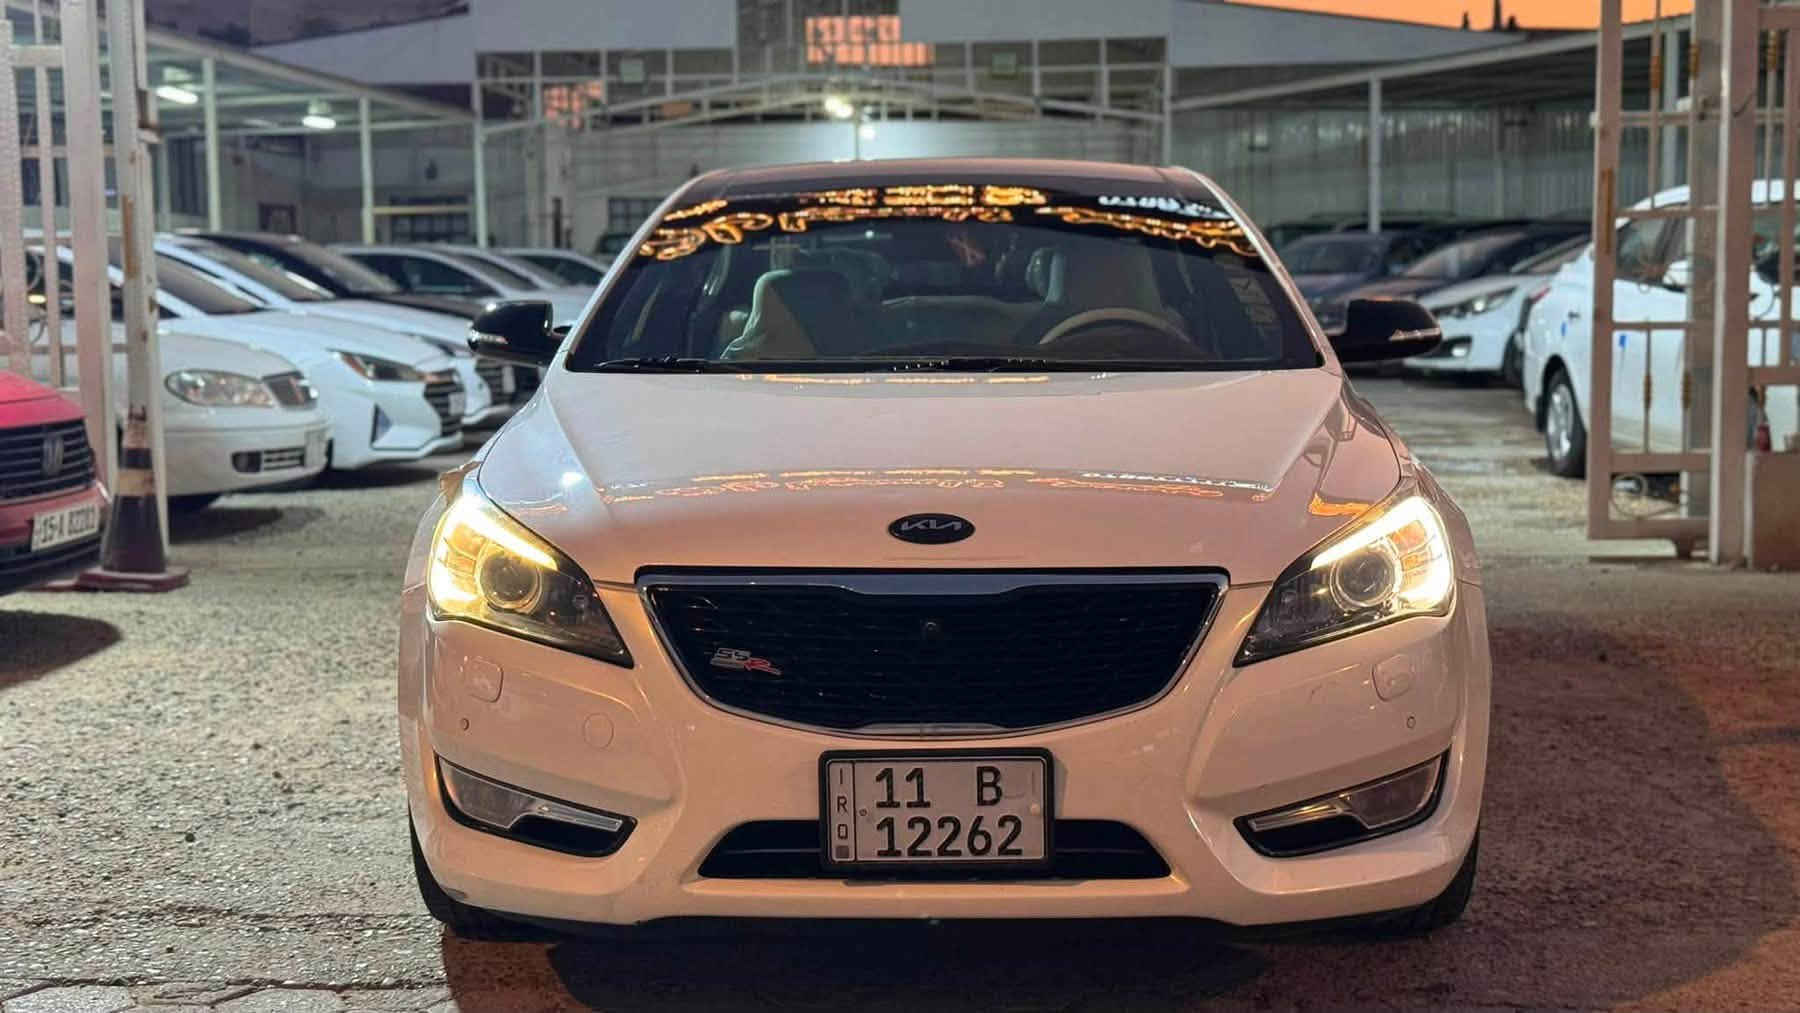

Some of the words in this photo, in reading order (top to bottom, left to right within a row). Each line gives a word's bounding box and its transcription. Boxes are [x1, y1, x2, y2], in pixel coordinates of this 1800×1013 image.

[901, 519, 962, 531] KIA
[875, 767, 931, 809] 11
[976, 766, 1003, 807] B
[876, 815, 1023, 857] 12262
